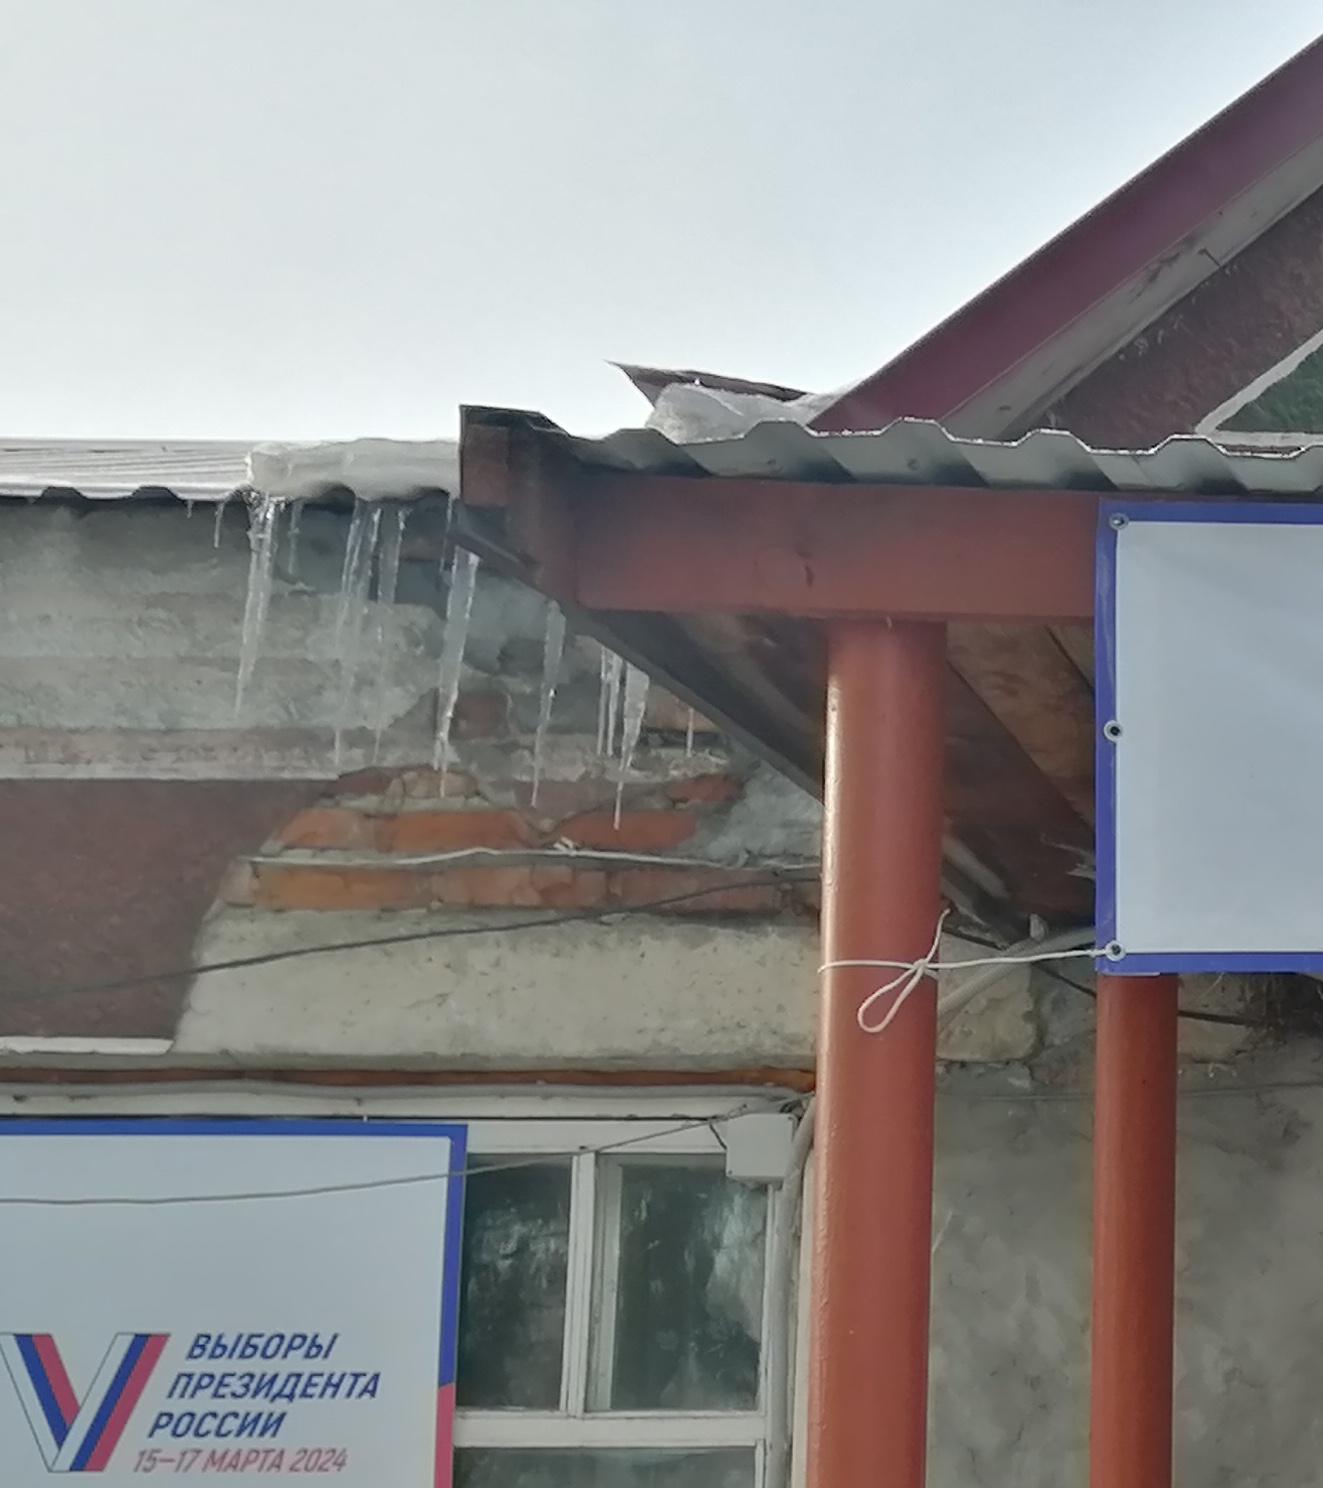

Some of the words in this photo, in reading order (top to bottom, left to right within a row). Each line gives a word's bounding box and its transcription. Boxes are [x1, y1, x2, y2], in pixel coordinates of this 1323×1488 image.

[187, 1334, 338, 1359] ВЫБОРЫ
[167, 1372, 380, 1402] ПРЕЗИДЕНТА
[148, 1412, 286, 1438] РОССИИ
[202, 1449, 286, 1472] МАРТА
[290, 1448, 348, 1472] 2024
